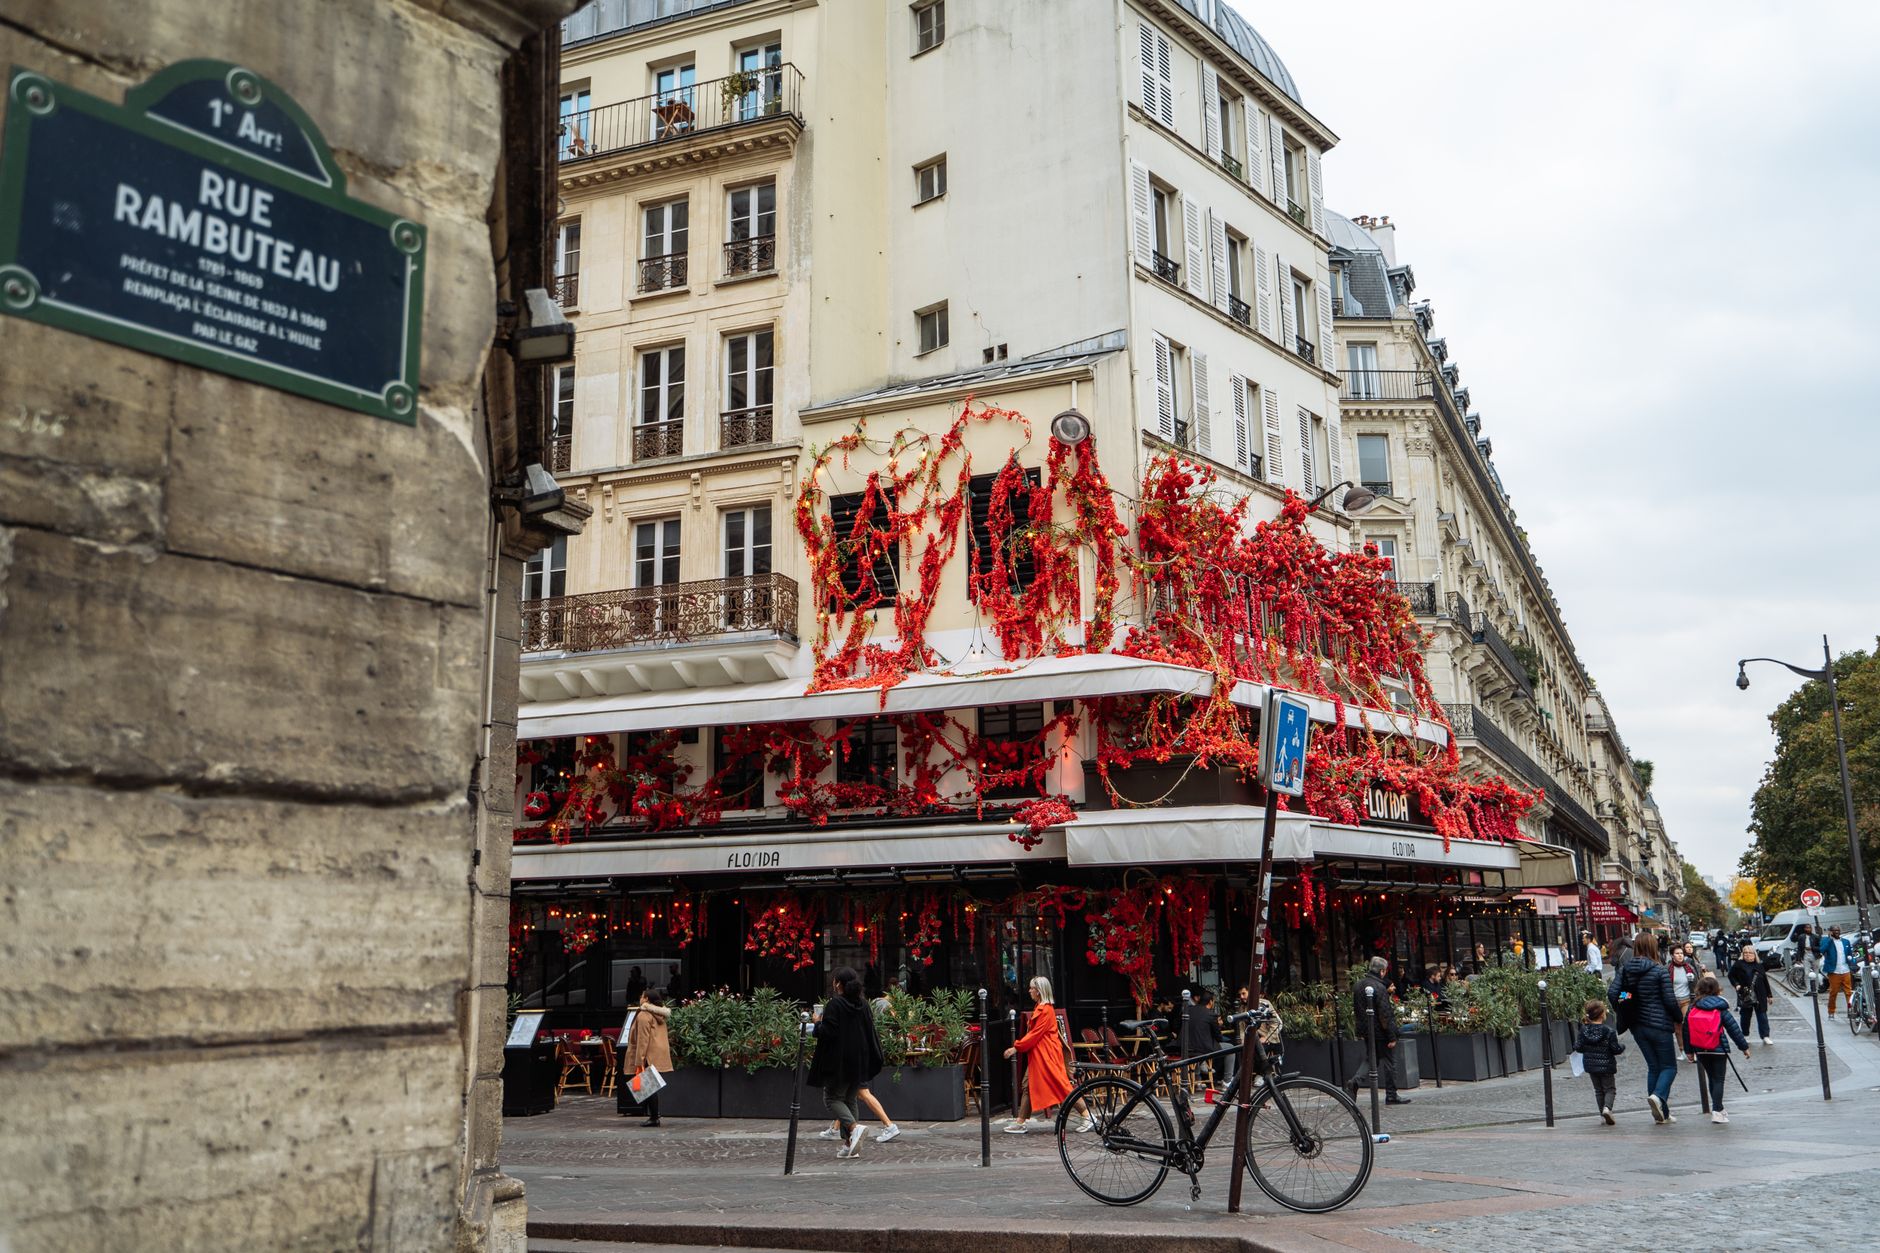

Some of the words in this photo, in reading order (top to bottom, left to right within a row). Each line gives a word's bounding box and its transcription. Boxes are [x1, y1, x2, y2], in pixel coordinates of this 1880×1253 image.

[199, 168, 274, 228] RUE
[114, 183, 340, 292] RAMBUTEAU
[120, 253, 169, 280] PRÉFET
[169, 269, 188, 288] DE
[187, 276, 204, 292] LA
[206, 281, 242, 304] SEINE
[243, 293, 260, 310] DE
[123, 278, 192, 312] REMPLAÇA
[192, 321, 217, 340] PAR
[218, 330, 234, 345] LE
[234, 334, 259, 353] GAZ
